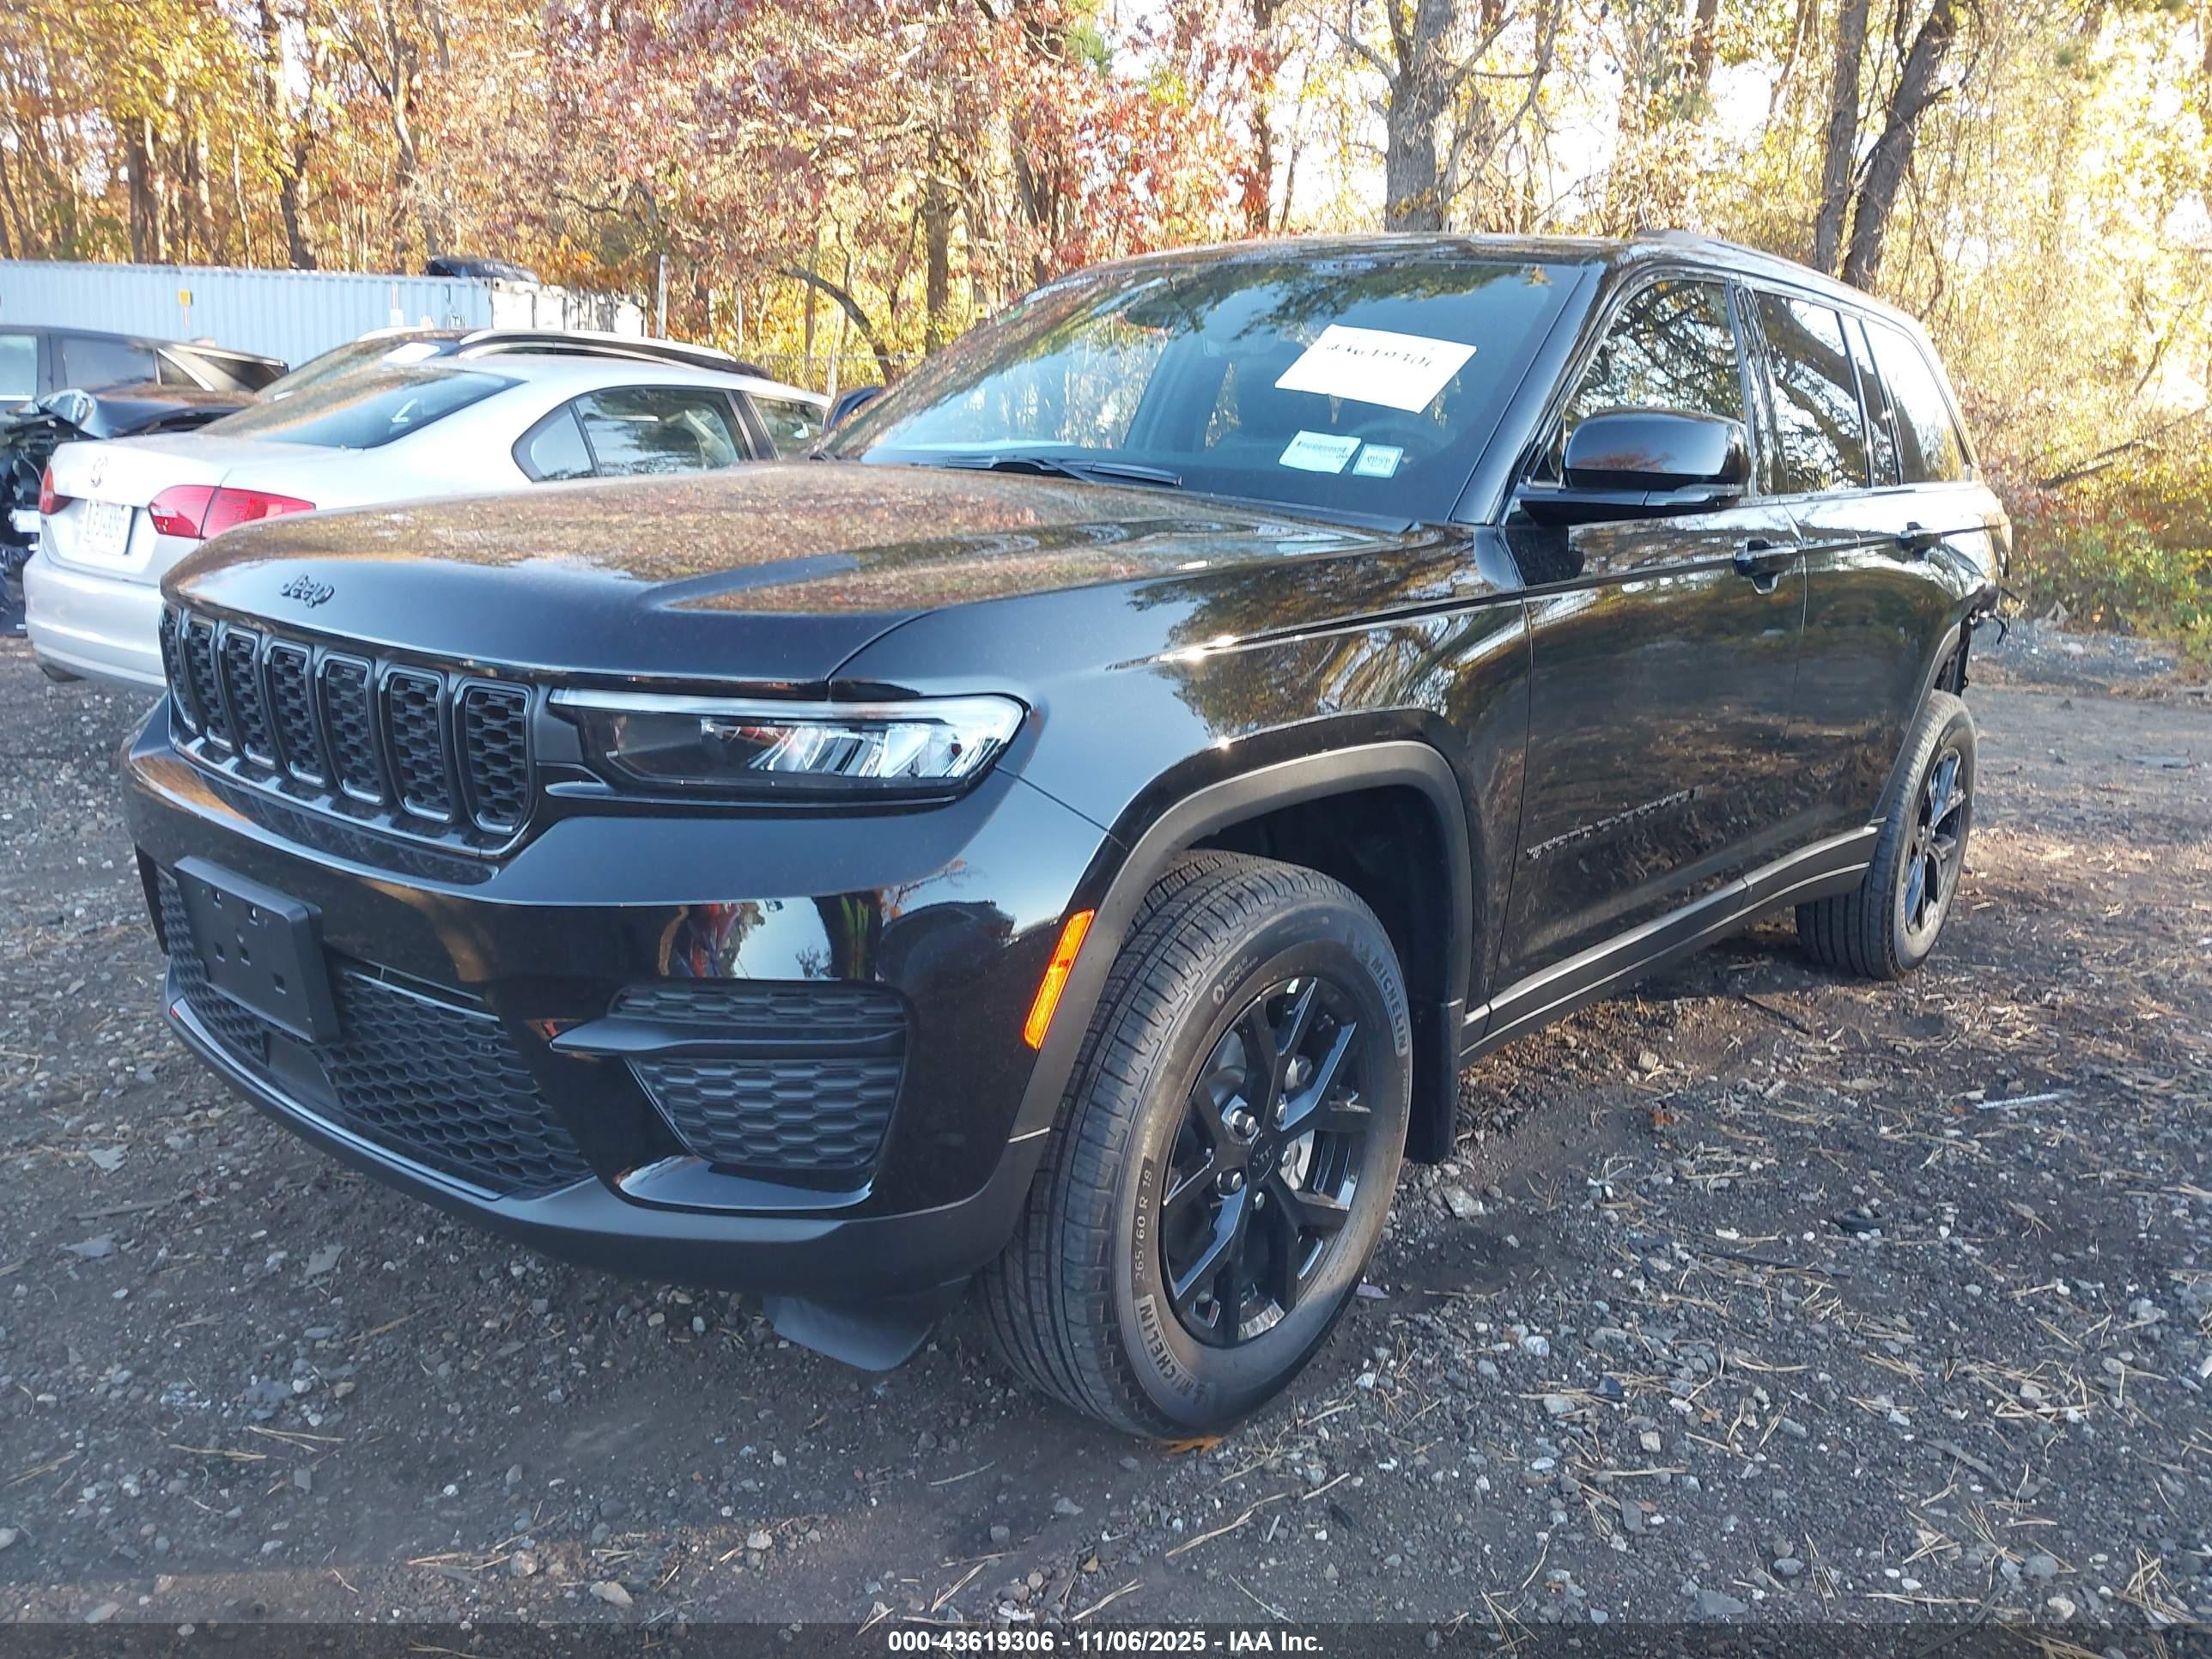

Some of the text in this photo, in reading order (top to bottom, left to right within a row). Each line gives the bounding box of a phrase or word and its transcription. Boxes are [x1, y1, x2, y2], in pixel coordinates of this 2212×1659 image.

[280, 574, 336, 608] Jeep
[1370, 955, 1408, 1052] MICHELIN
[1139, 1196, 1149, 1209] R
[1134, 1215, 1146, 1281] 265/60
[1139, 1303, 1194, 1397] MICHELIN
